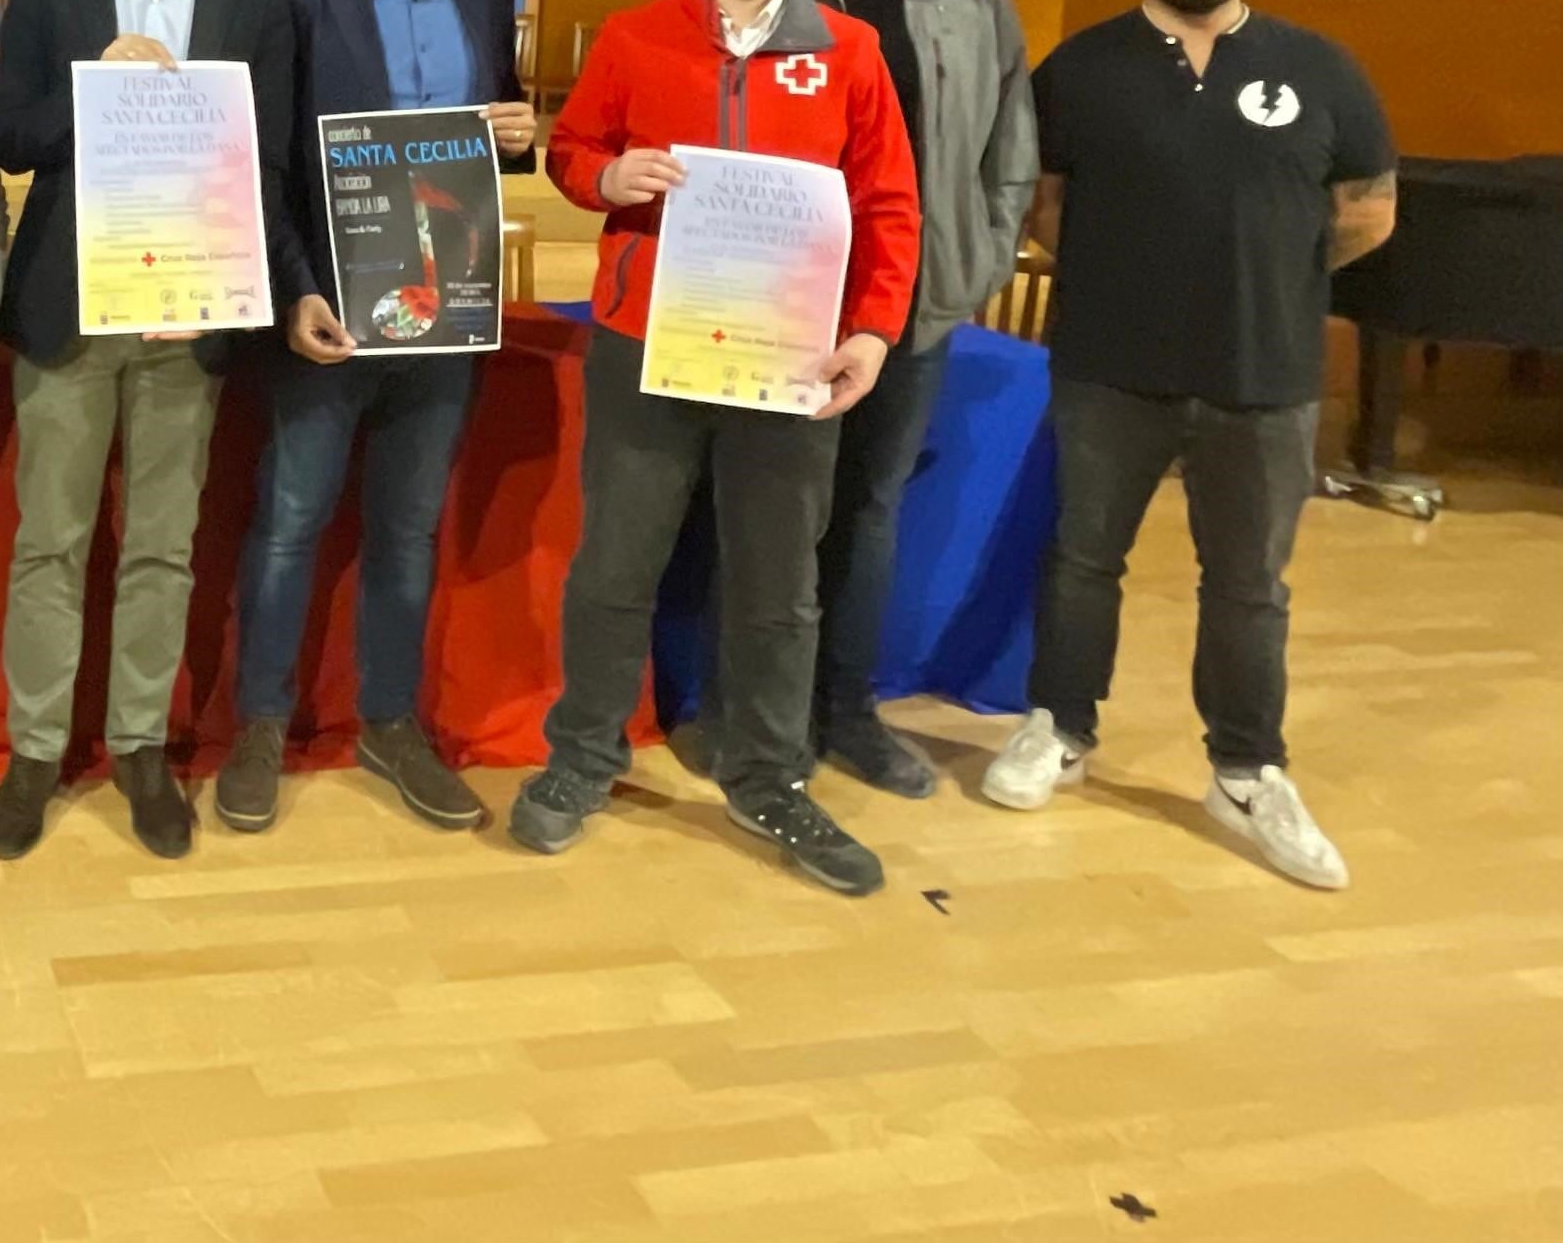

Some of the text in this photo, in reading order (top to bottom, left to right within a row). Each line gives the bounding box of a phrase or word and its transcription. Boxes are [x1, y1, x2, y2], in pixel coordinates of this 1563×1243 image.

[123, 76, 194, 91] FESTIVAL
[117, 92, 207, 107] SOLIDARIO
[102, 108, 227, 125] SANTA CECILIA
[330, 137, 487, 168] SANTA CECILIA
[721, 166, 794, 186] FESTIVAL
[714, 182, 807, 204] SOLIDARIO
[694, 194, 824, 222] SANTA CECILIA
